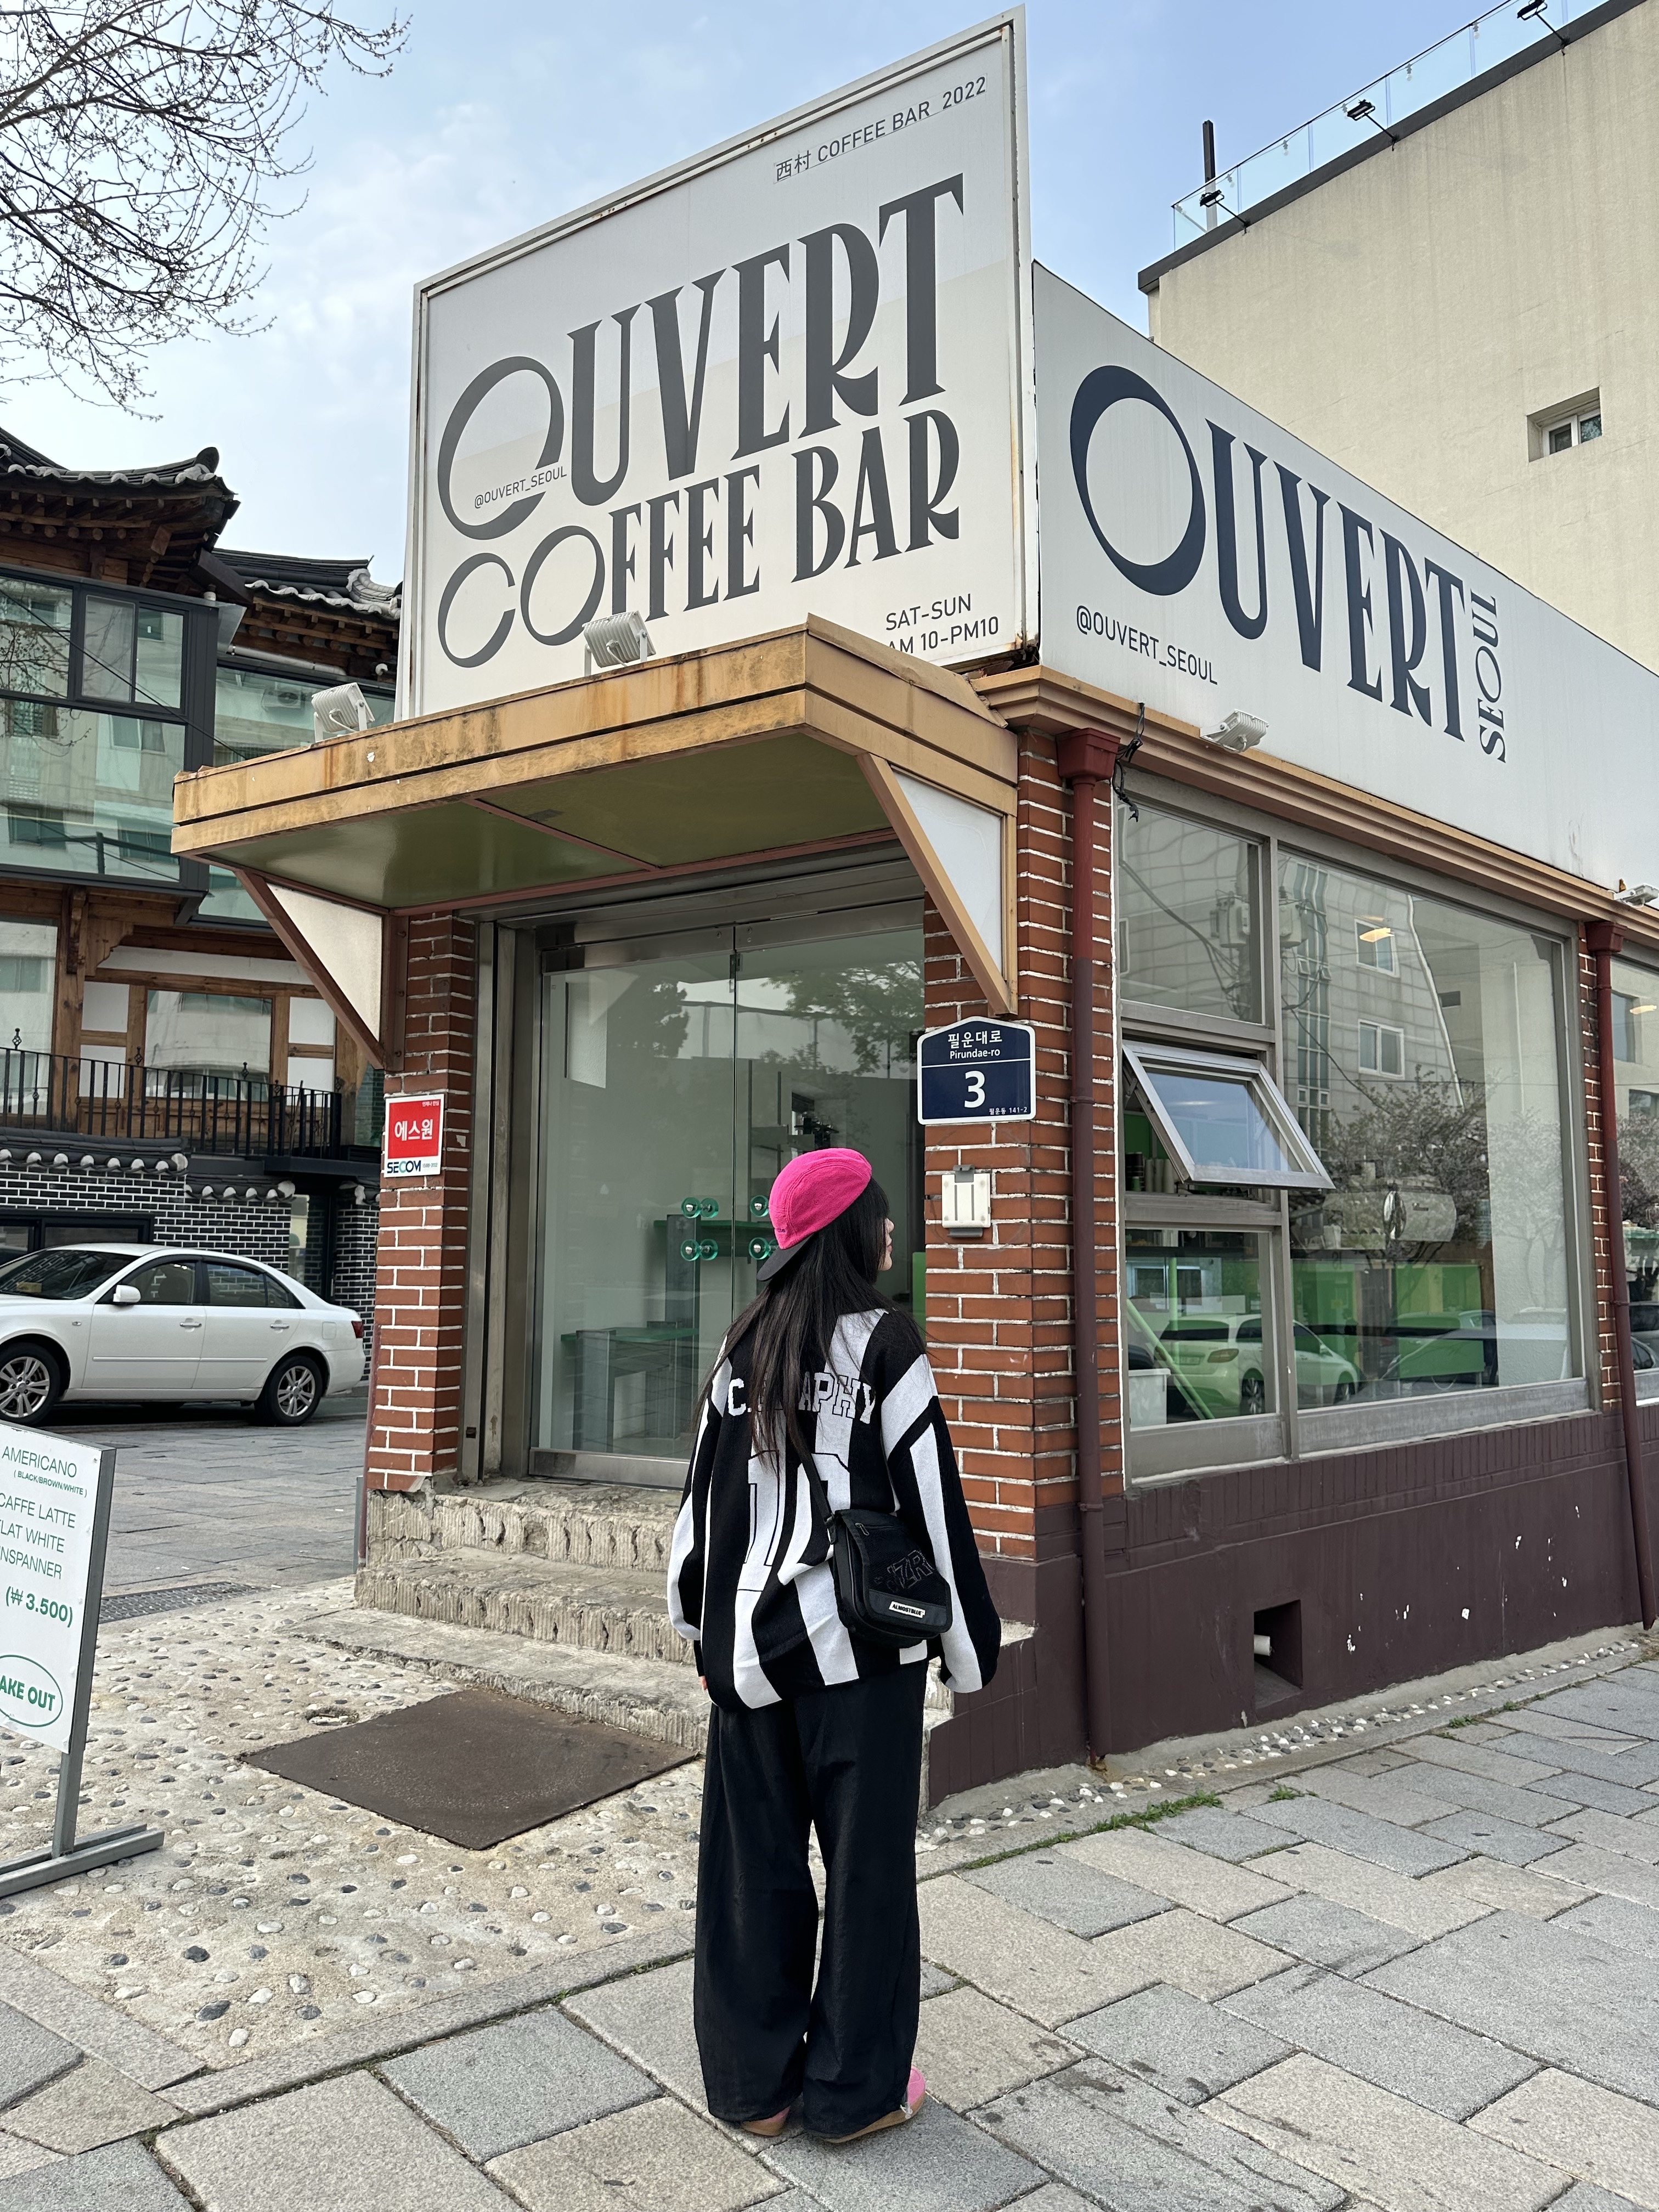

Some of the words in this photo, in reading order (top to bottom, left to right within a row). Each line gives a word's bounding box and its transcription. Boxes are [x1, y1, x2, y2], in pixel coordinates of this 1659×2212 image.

[818, 120, 885, 162] COFFEE
[893, 101, 930, 131] BAR
[943, 76, 986, 110] 2022
[438, 173, 963, 540] OUVERT
[475, 466, 567, 509] @OUVERT_SEOUL
[438, 465, 759, 668] COFFEE
[792, 410, 960, 583] BAR
[1070, 365, 1466, 742] OUVERT
[886, 594, 970, 630] SAT-SUN
[921, 616, 998, 651] 10-PM10
[1076, 605, 1217, 685] @OUVERT_SEOUL
[1470, 588, 1506, 763] SEOUL
[948, 1030, 1002, 1049] 필운대로
[950, 1048, 1000, 1059] Pirundae-ro
[964, 1070, 985, 1108] 3
[989, 1107, 1006, 1115] 필운동
[394, 1119, 433, 1141] 에스원
[387, 1160, 421, 1173] SECOM
[2, 1446, 77, 1478] AMERICANO
[38, 1504, 76, 1528] LATTE
[0, 1519, 23, 1539] LAT
[26, 1527, 65, 1553] WHITE
[0, 1545, 62, 1579] NSPANNER
[0, 1675, 25, 1700] AKE
[28, 1686, 55, 1711] OUT
